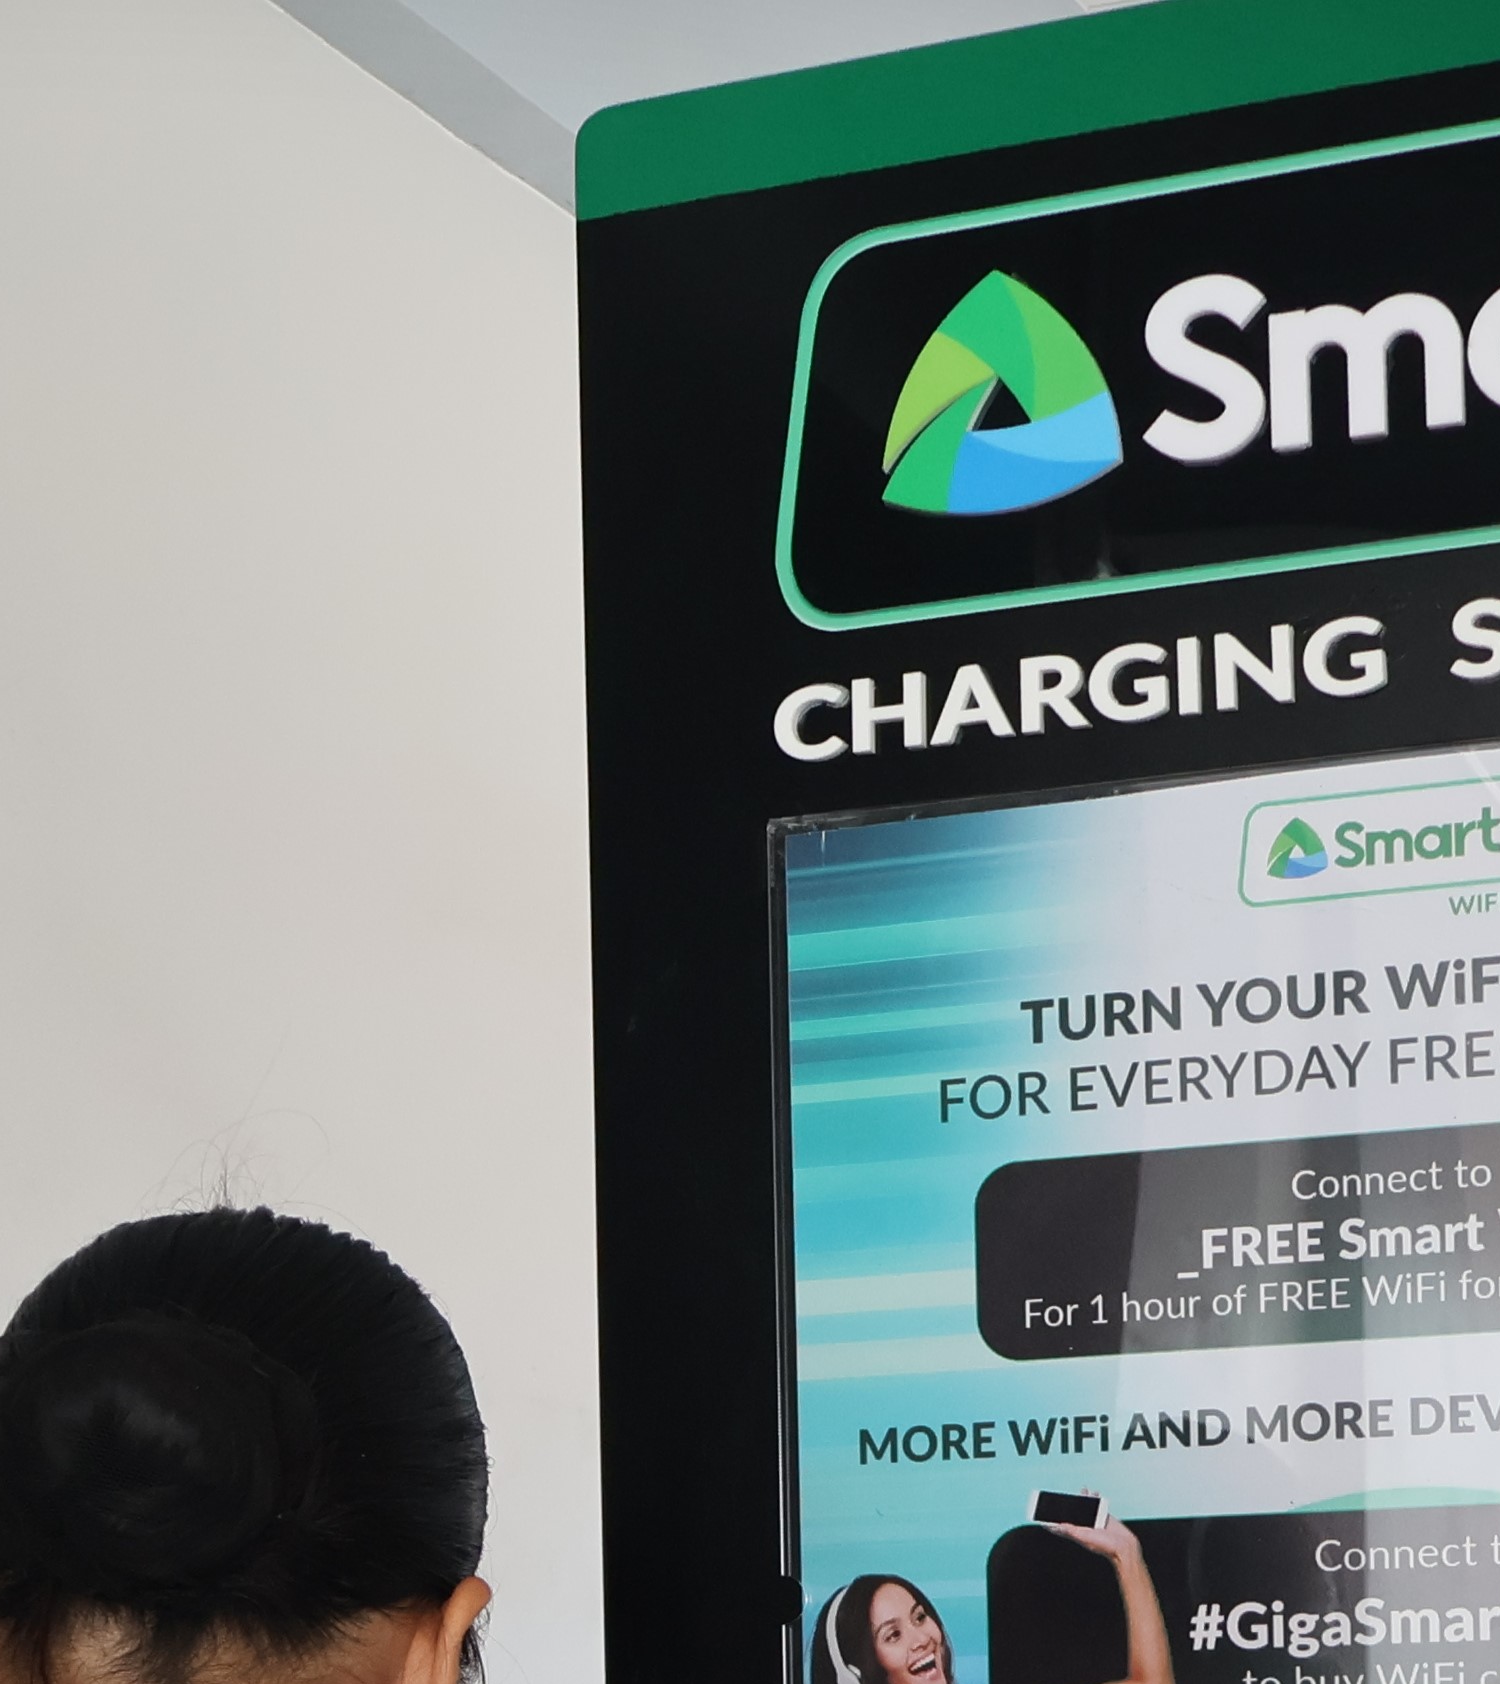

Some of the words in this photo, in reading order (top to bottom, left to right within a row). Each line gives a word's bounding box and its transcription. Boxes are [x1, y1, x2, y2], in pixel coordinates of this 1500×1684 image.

[772, 615, 1388, 761] CHARGING
[1021, 986, 1181, 1043] TURN
[1197, 969, 1370, 1028] YOUR
[940, 1071, 1050, 1123] FOR
[1070, 1041, 1371, 1111] EVERYDAY
[1291, 1167, 1442, 1201] Connect
[1453, 1160, 1492, 1191] to
[1177, 1219, 1325, 1279] _FREE
[1339, 1214, 1484, 1262] Smart
[1023, 1298, 1079, 1329] For
[1090, 1295, 1108, 1325] 1
[1121, 1289, 1201, 1323] hour
[1212, 1283, 1248, 1316] of
[1258, 1279, 1351, 1314] FREE
[1362, 1271, 1446, 1307] WiFi
[858, 1421, 996, 1465] MORE
[1007, 1414, 1110, 1457] WiFi
[1122, 1408, 1231, 1452] AND
[1245, 1399, 1394, 1444] MORE
[1315, 1535, 1477, 1572] Connect
